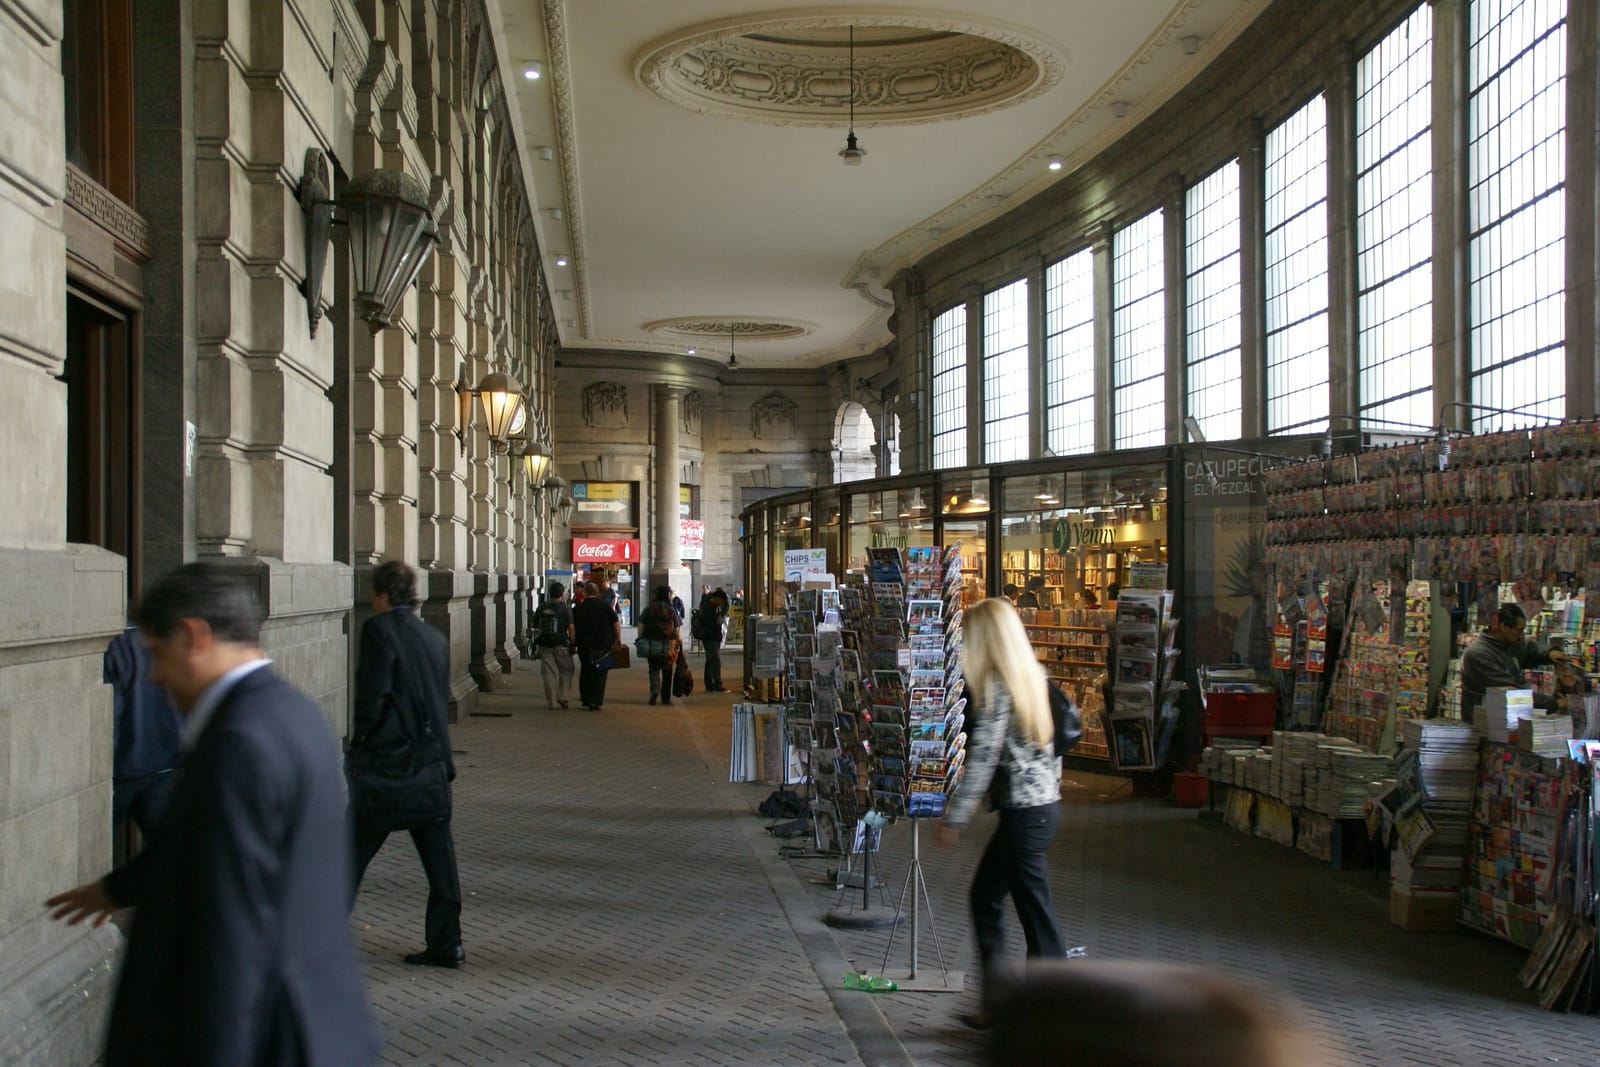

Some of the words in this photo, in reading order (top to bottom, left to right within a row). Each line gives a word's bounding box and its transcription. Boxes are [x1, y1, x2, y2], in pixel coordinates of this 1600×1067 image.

[1194, 483, 1208, 496] EL
[1211, 481, 1256, 496] MEZCAL
[1072, 522, 1117, 549] Yenny
[785, 554, 809, 564] CHIPS
